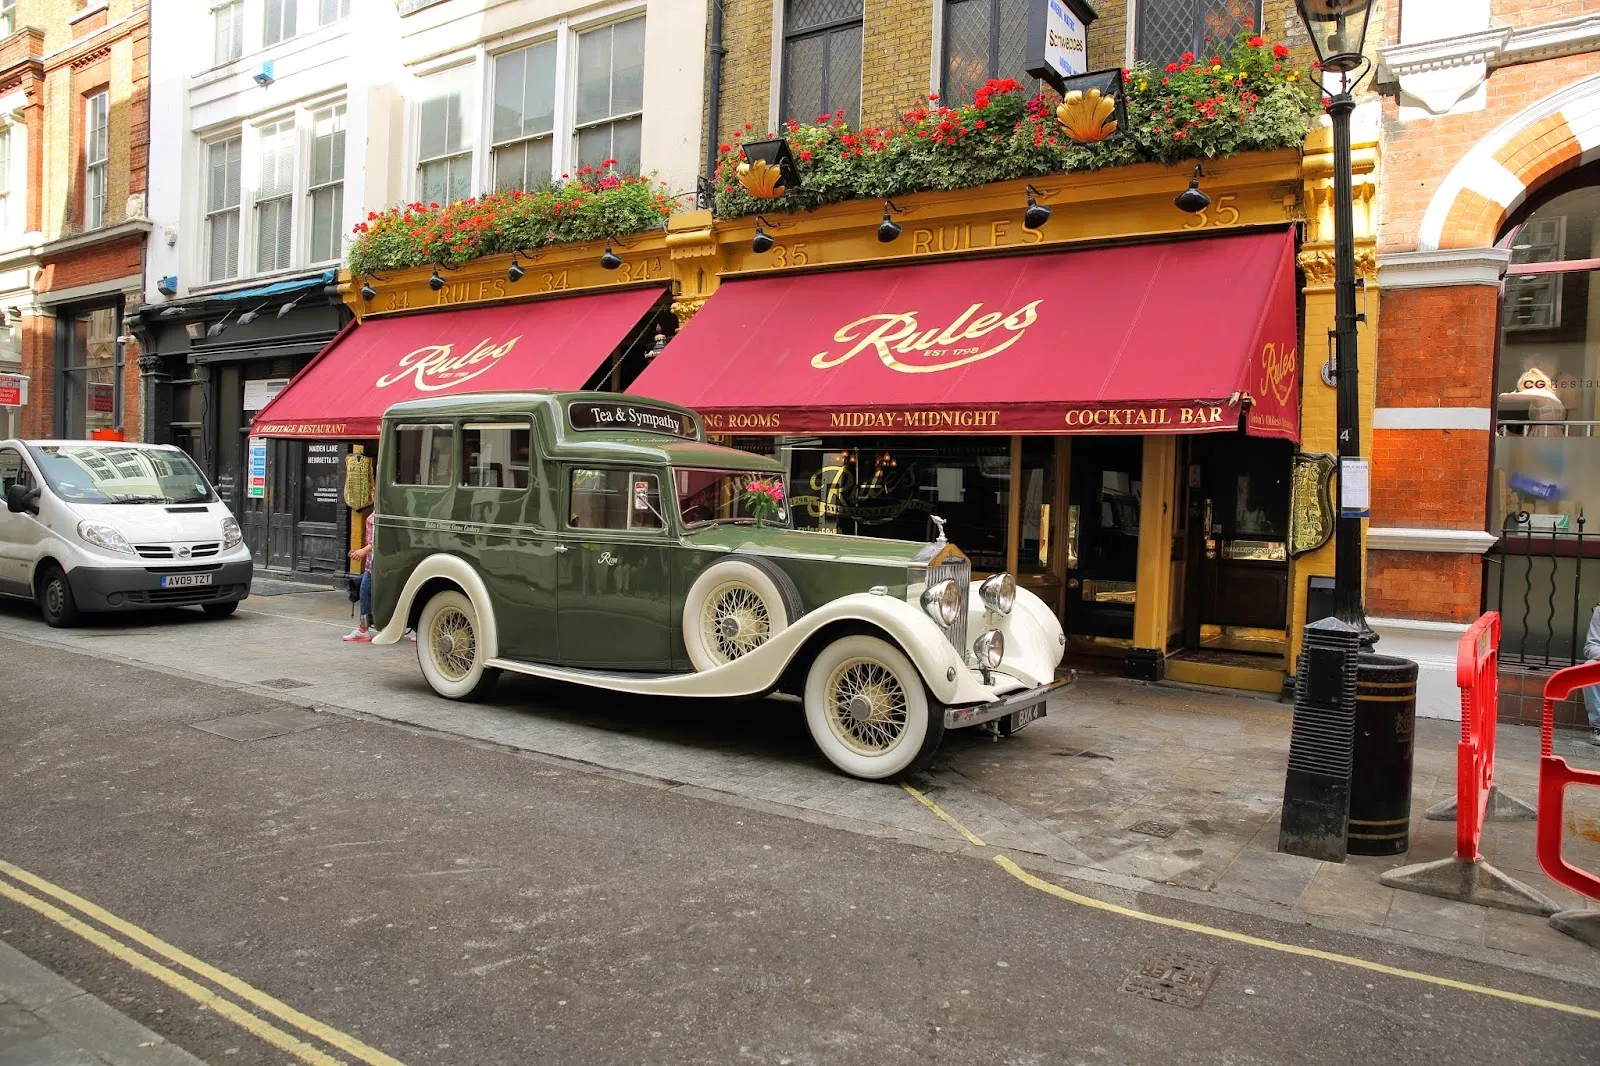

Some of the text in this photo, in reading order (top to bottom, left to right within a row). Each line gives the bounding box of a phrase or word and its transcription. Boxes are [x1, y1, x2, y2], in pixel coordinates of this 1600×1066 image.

[1049, 29, 1083, 52] Schweppes
[769, 219, 1044, 268] 35 RULES
[385, 269, 569, 311] 34 RULES 34
[811, 299, 1044, 373] Rules
[375, 334, 523, 391] Rules
[923, 347, 979, 357] EST 1798
[1260, 342, 1296, 406] Rules
[1523, 380, 1546, 389] CG
[591, 407, 680, 433] Tea & Sympathy
[728, 413, 781, 428] ROOMS
[830, 410, 1000, 428] MIDDAY-MIDNIGHT
[1065, 406, 1223, 426] COCKTAIL BAR
[261, 425, 297, 433] HERITAGE
[297, 423, 347, 434] RESTAURANT
[1340, 428, 1351, 442] 4
[326, 445, 338, 453] LANE
[168, 574, 211, 586] AV09 TZT
[1019, 703, 1039, 726] BXK 4
